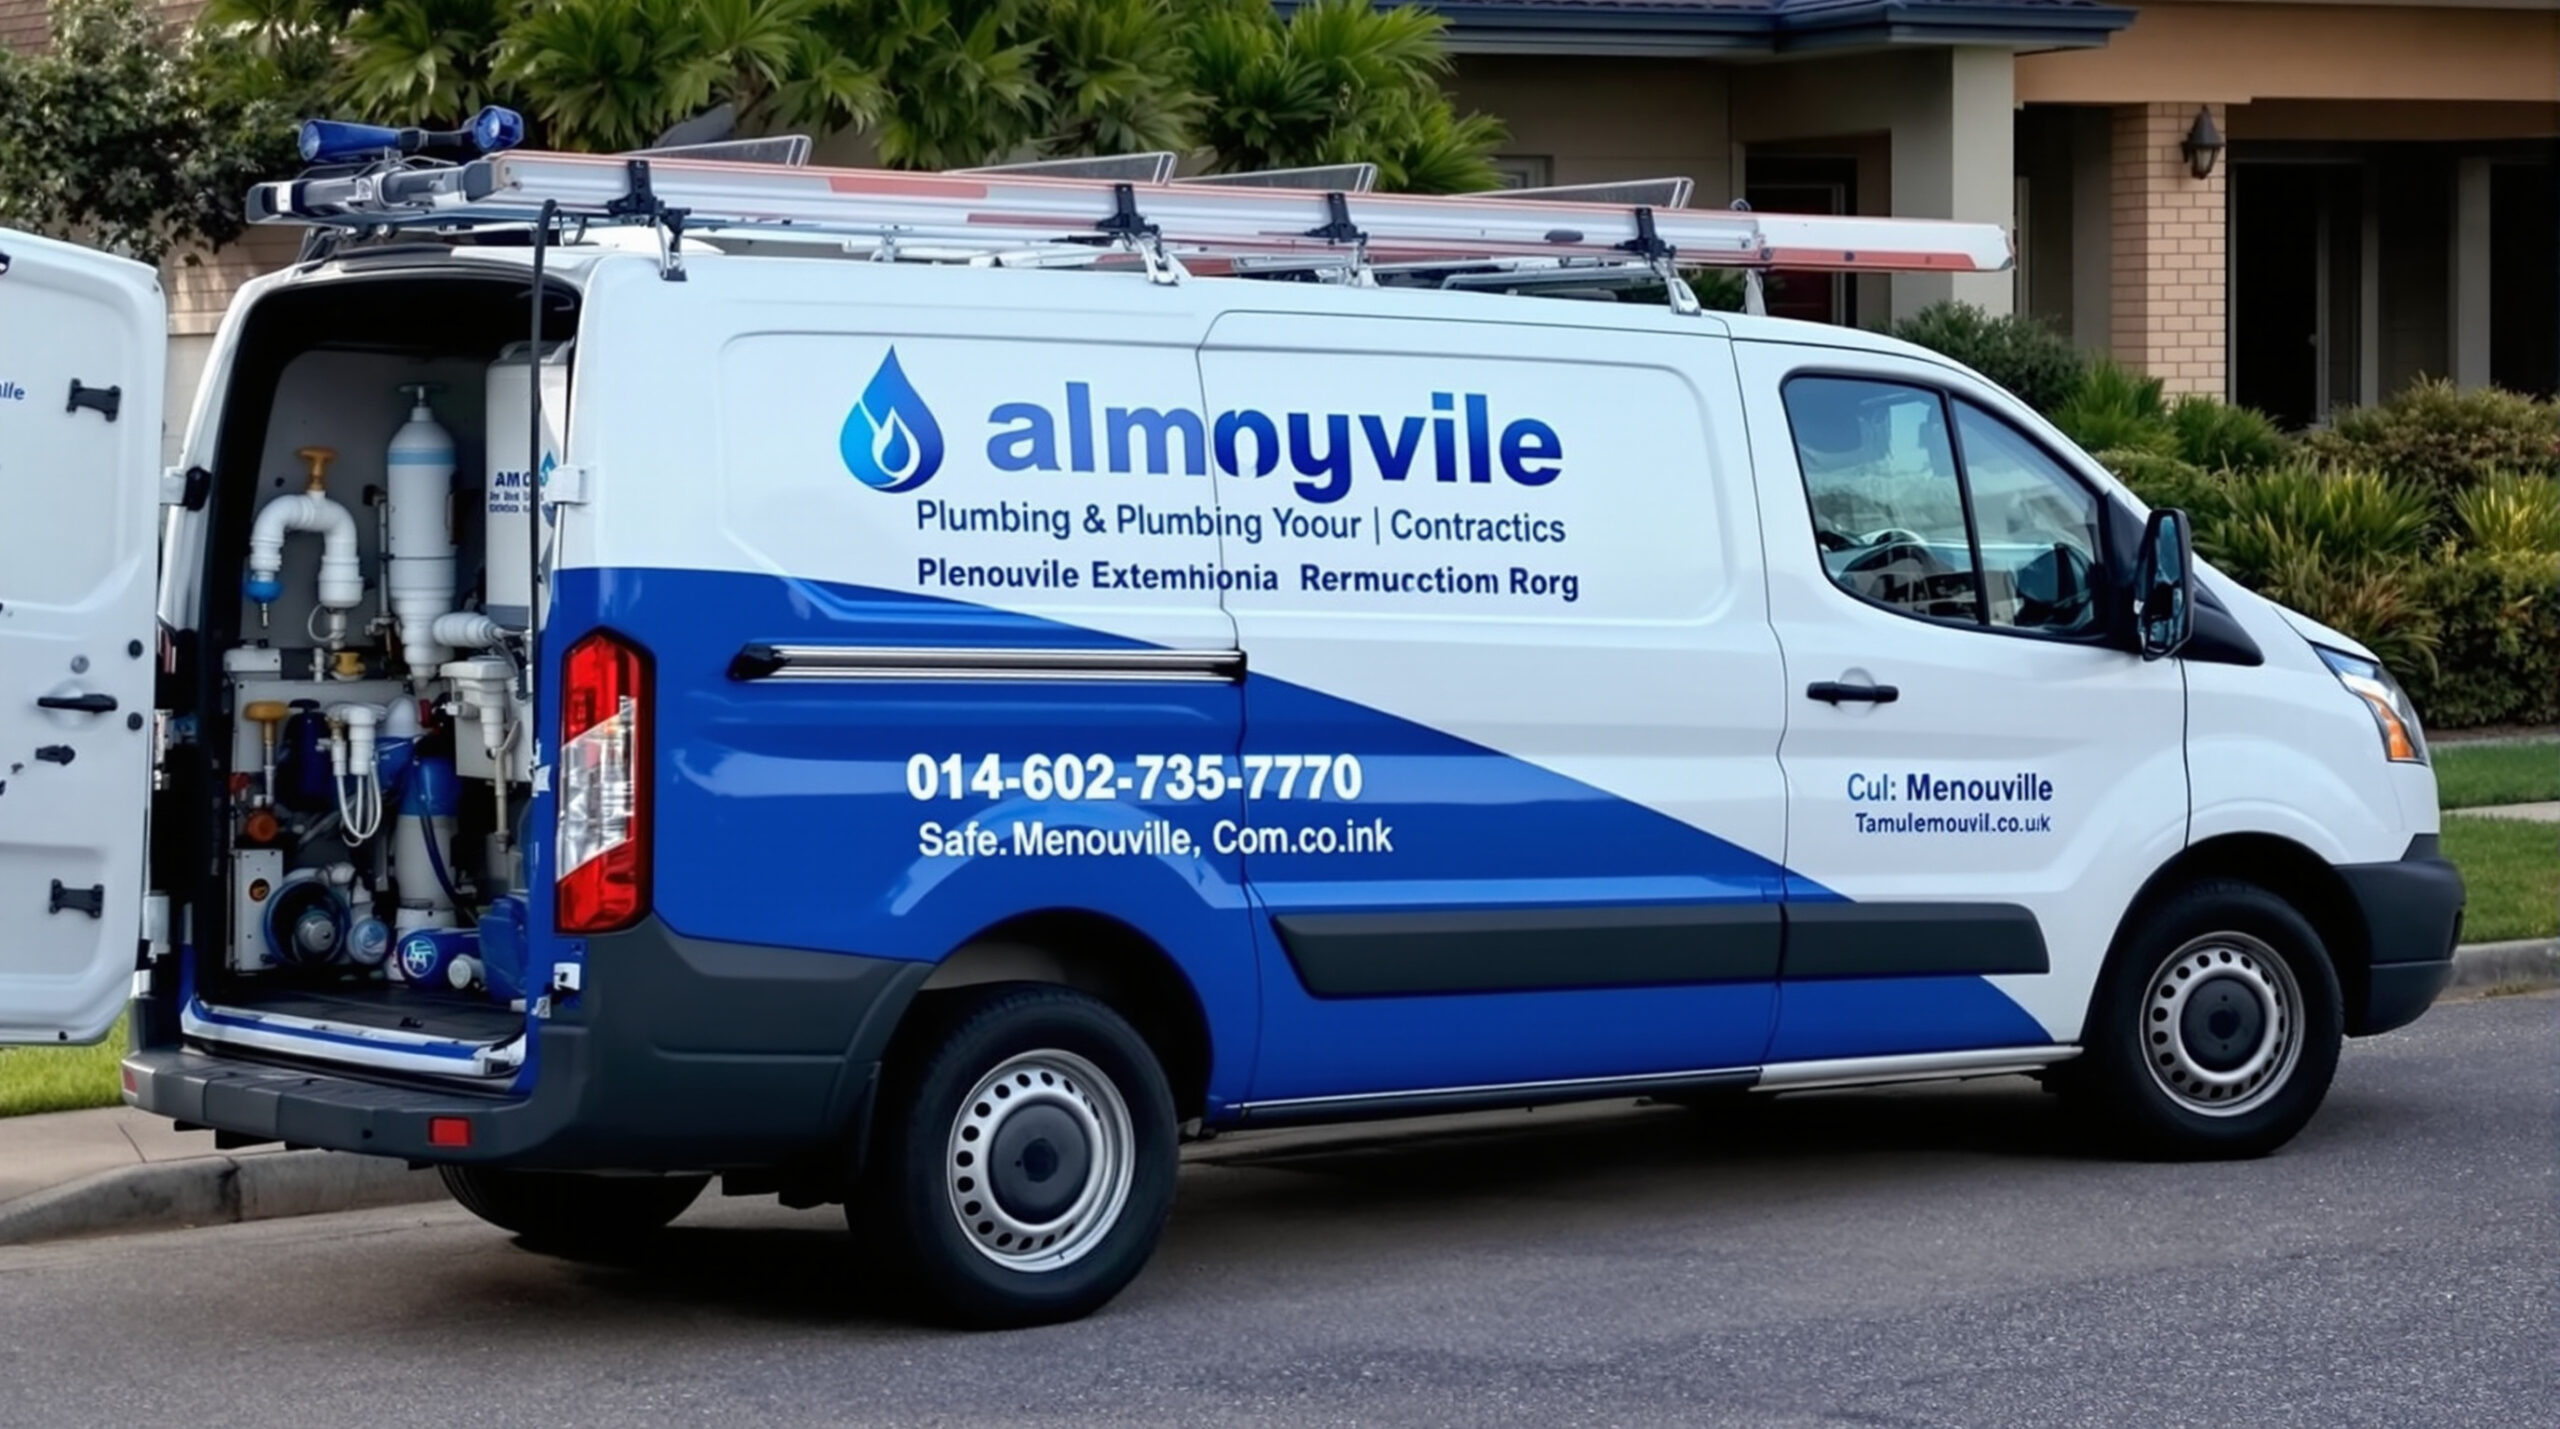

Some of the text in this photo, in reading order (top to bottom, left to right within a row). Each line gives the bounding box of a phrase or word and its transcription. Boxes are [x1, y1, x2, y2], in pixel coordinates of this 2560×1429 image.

[917, 500, 1071, 540] Plumbing
[1083, 504, 1107, 534] &
[1117, 504, 1263, 544] Plumbing
[1272, 507, 1362, 539] Yoour
[1391, 509, 1566, 543] Contractics
[917, 558, 1080, 589] Plenouvile
[1509, 567, 1579, 602] Rorg
[906, 753, 1363, 801] 014-602-735-7770
[1847, 773, 2054, 801] Cul: Menouville
[918, 818, 1394, 858] Safe. Menouville, Com.co.ink
